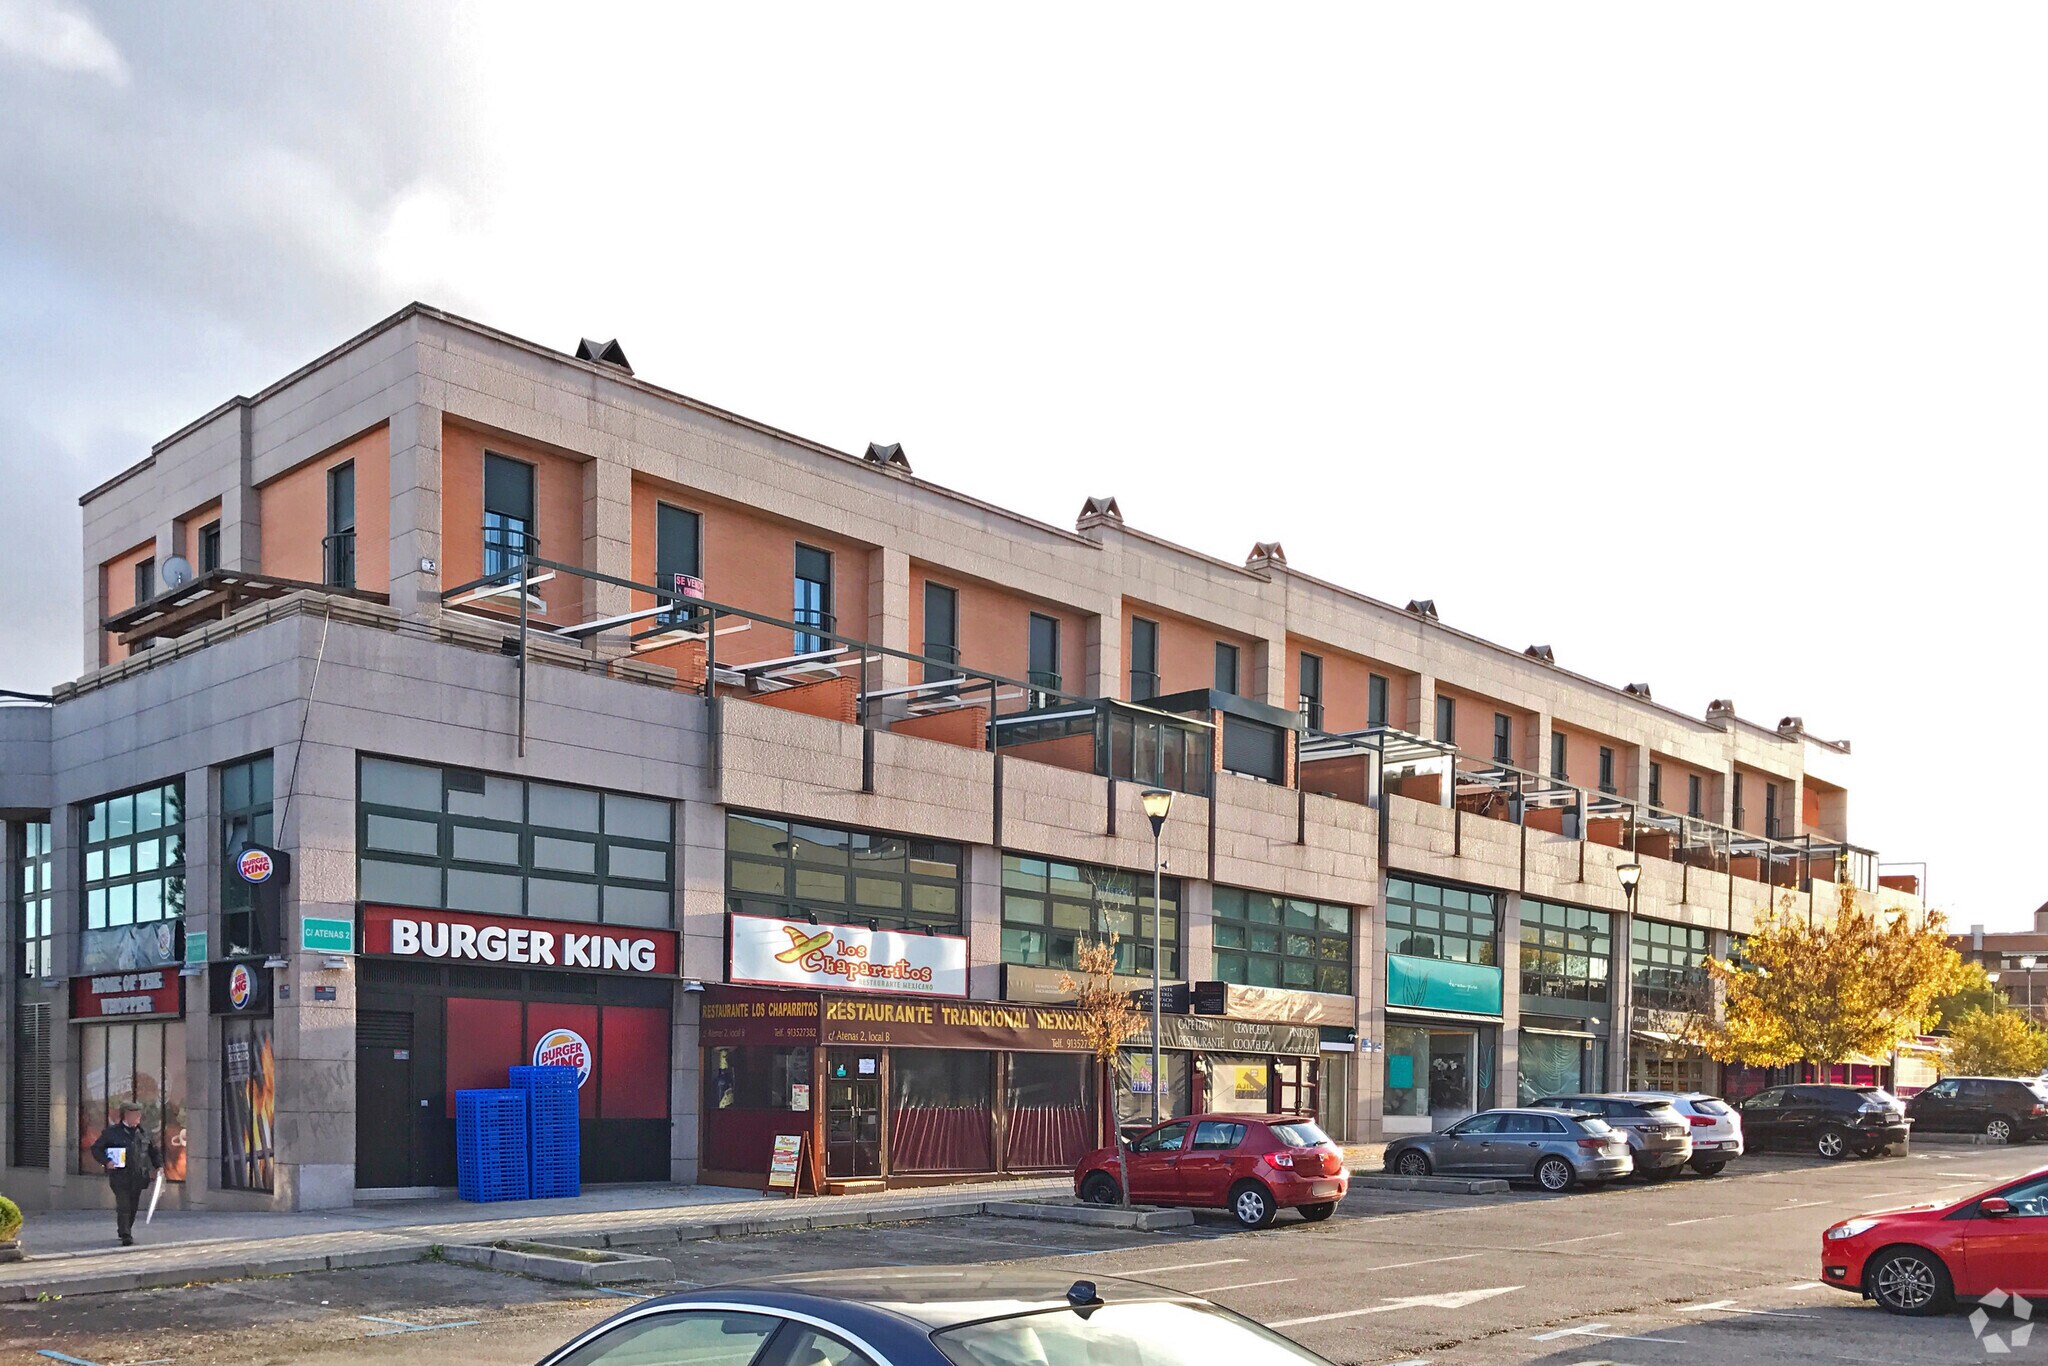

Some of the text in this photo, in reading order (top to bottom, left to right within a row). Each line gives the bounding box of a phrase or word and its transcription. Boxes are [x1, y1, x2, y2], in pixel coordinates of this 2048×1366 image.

[676, 576, 686, 586] SE
[242, 856, 269, 868] BURGER
[243, 863, 270, 876] KING
[314, 929, 344, 939] ATENAS
[345, 930, 350, 939] 2
[392, 918, 657, 972] BURGER KING
[837, 940, 867, 958] los
[800, 950, 933, 982] Chaparritos
[859, 978, 934, 991] RESTAURANTE MEXICANO
[702, 1002, 818, 1018] RESTAURANTE LOS CHAPARRITOS
[826, 1001, 1091, 1031] RESTAURANTE TRADICIONAL MEXICAN
[828, 1030, 836, 1041] c/
[837, 1030, 859, 1041] Atenas
[869, 1031, 884, 1042] local
[885, 1031, 891, 1042] B
[1179, 1035, 1225, 1048] RESTAURANTE
[1051, 1038, 1064, 1048] Telf.
[541, 1042, 583, 1064] BURGER
